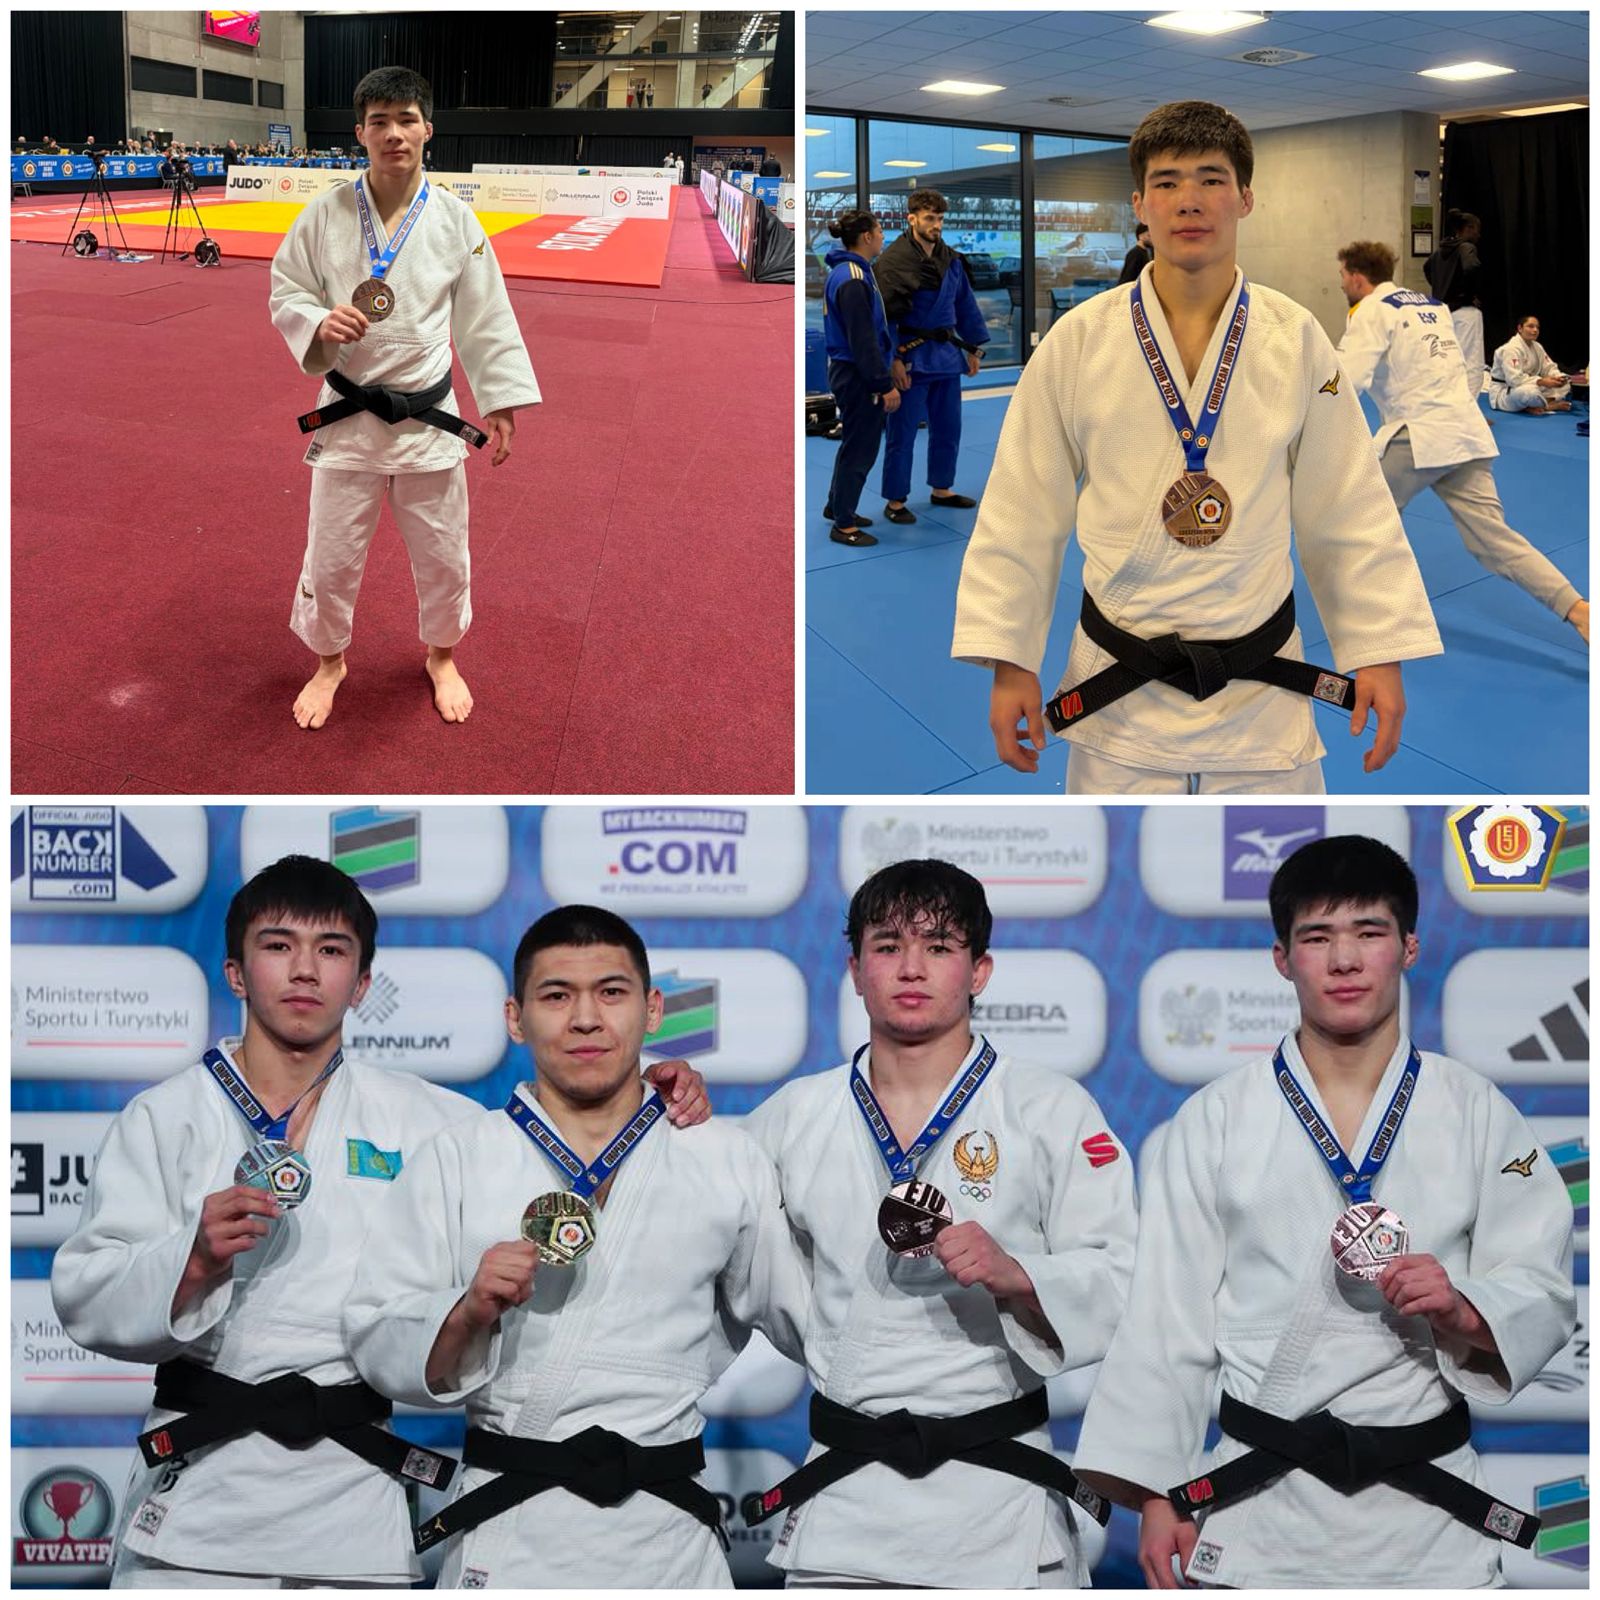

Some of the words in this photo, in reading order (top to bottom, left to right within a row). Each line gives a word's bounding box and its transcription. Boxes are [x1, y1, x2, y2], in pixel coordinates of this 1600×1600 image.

[229, 177, 262, 190] JUDO
[1417, 312, 1437, 324] ESP
[1133, 304, 1150, 340] EUROPEAN
[1143, 340, 1158, 361] JUDO
[1152, 360, 1168, 383] TOUR
[1161, 382, 1178, 406] 2026
[1208, 366, 1230, 410] EUROPEAN
[1222, 345, 1236, 367] JUDO
[1229, 324, 1242, 345] TOUR
[34, 811, 79, 820] OFFICIAL
[33, 829, 113, 856] BACK
[927, 824, 1049, 842] Ministerstwo
[33, 855, 112, 873] NUMBER
[608, 841, 737, 875] .COM
[927, 848, 990, 865] Sportu
[1006, 848, 1088, 867] Turystyki
[68, 884, 110, 895] .com
[26, 986, 149, 1004] Ministerstwo
[26, 1011, 88, 1030] Sportu
[105, 1011, 189, 1030] Turystyki
[971, 1004, 1067, 1021] ZEBRA
[904, 1182, 946, 1214] EJU
[1332, 1206, 1372, 1247] EJU
[24, 1344, 86, 1365] Sportu
